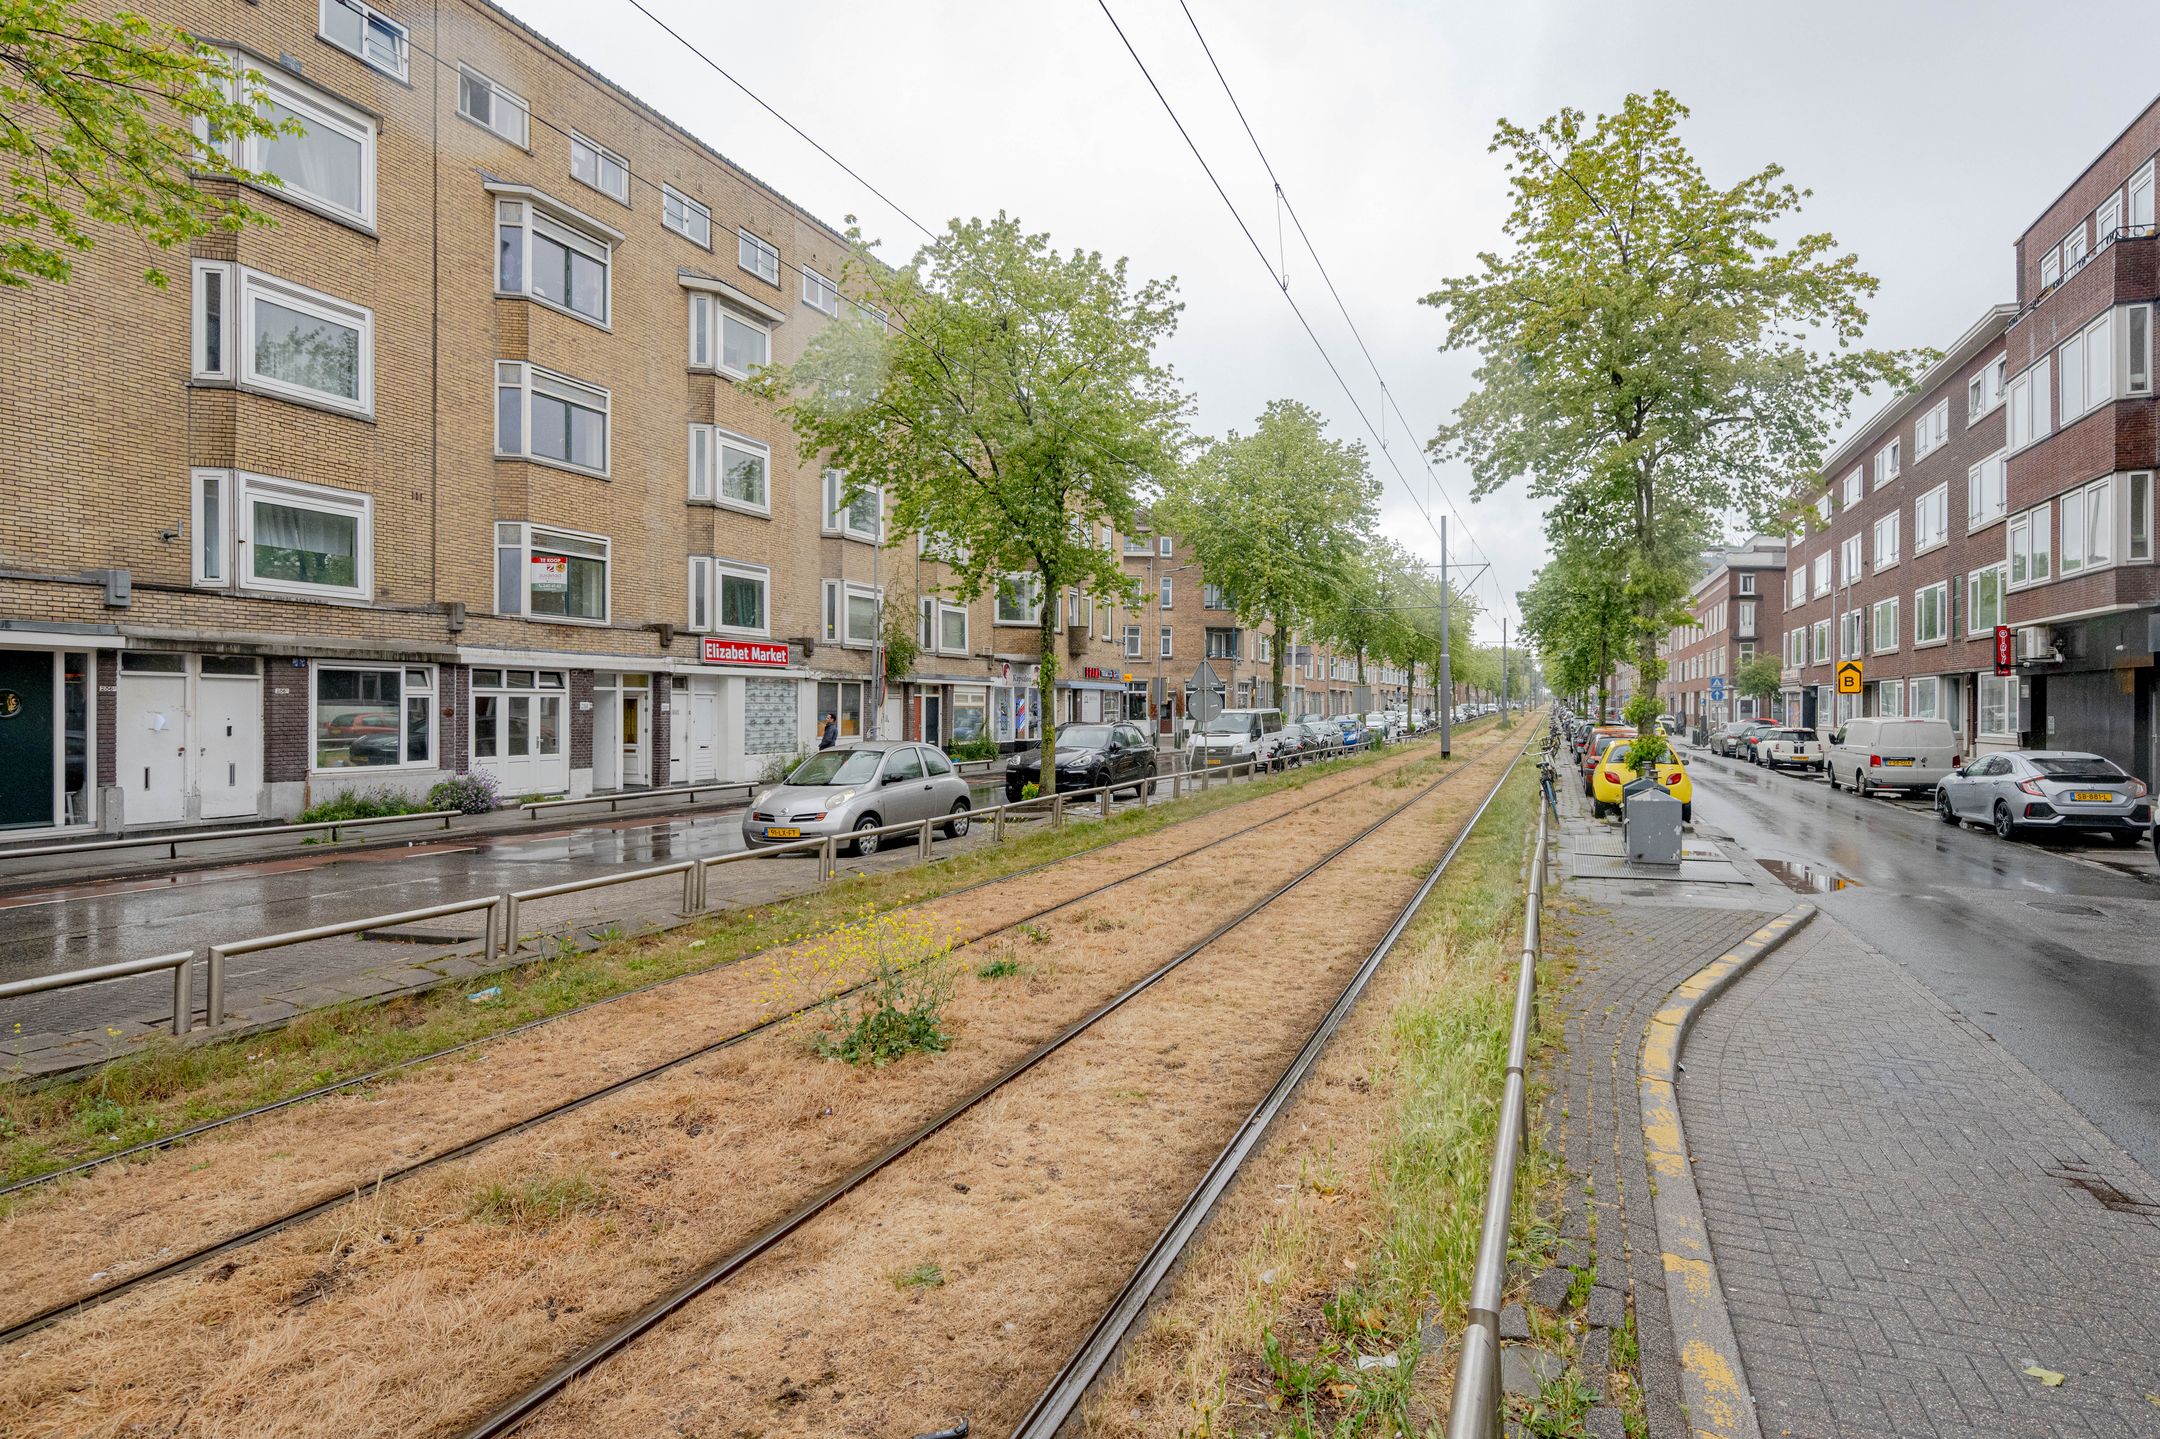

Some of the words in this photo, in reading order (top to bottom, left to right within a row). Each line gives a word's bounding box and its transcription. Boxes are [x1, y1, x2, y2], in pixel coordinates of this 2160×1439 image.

[706, 643, 750, 660] Elizabet
[751, 647, 787, 662] Market
[1844, 676, 1855, 687] B
